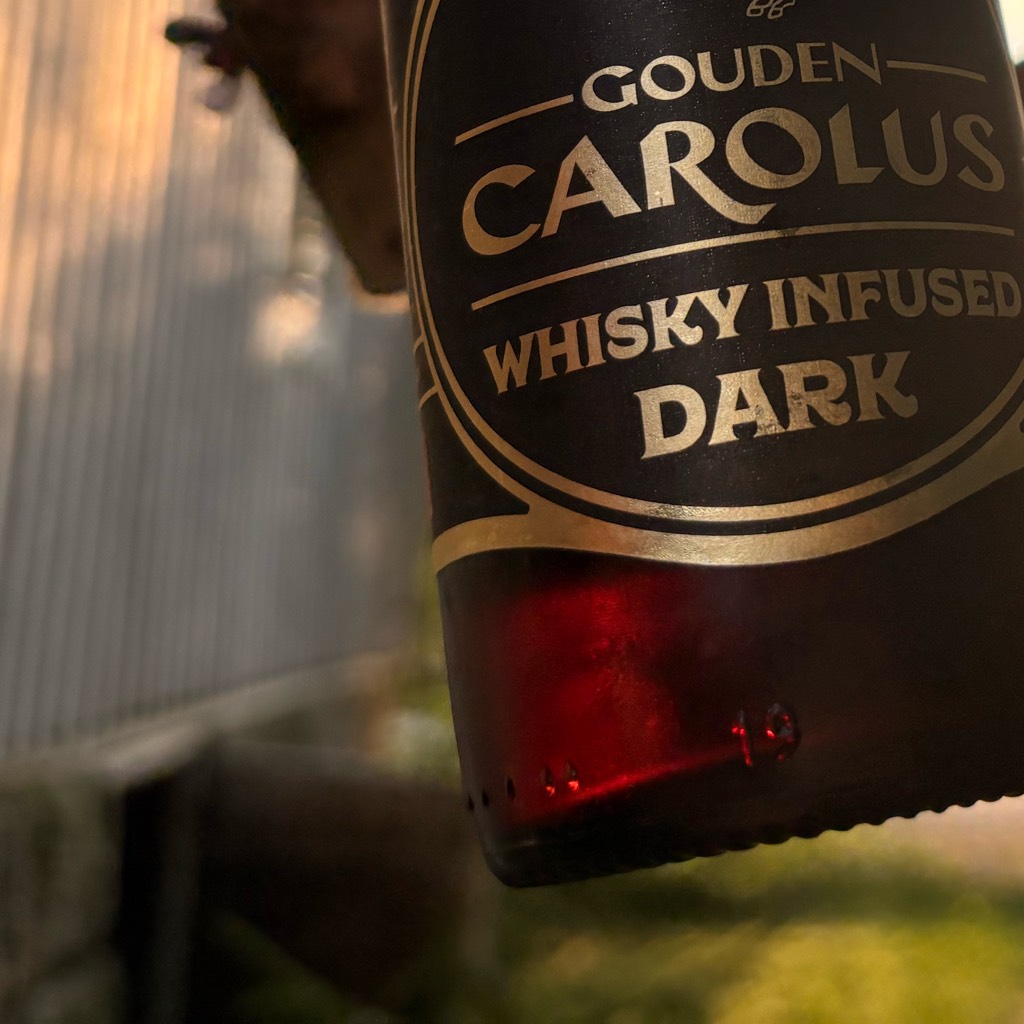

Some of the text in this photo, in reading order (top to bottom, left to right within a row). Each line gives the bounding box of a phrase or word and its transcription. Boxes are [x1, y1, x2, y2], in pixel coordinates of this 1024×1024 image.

[581, 42, 881, 112] GOUDEN
[462, 104, 1005, 255] CAROLUS
[483, 269, 1022, 394] WHISKY INFUSED
[633, 351, 918, 461] DARK
